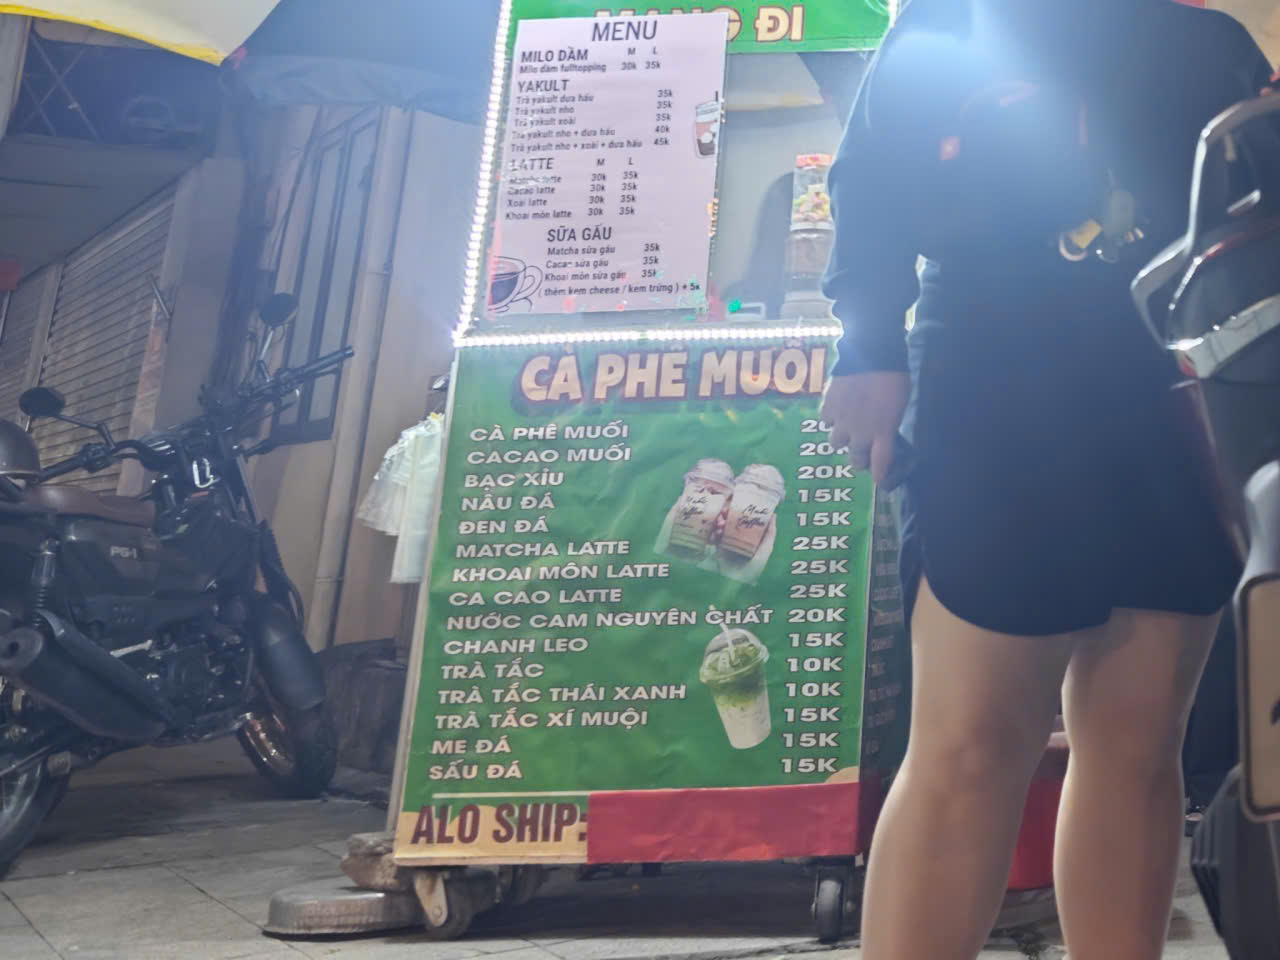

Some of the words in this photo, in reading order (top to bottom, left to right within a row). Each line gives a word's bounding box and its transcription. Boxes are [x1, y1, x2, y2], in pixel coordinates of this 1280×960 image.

[592, 20, 658, 42] MENU
[754, 4, 805, 43] ĐI
[521, 50, 554, 63] MILO
[628, 48, 636, 56] M
[652, 47, 658, 55] L
[520, 65, 538, 74] Milo
[560, 62, 607, 74] fulltopping
[621, 62, 637, 71] 30k
[645, 61, 661, 70] 35k
[518, 79, 570, 93] YAKULT
[515, 107, 528, 116] Trà
[530, 106, 556, 116] yakult
[558, 106, 575, 114] nho
[656, 101, 672, 110] 35k
[516, 96, 530, 105] Trà
[532, 95, 558, 105] yakult
[658, 90, 673, 98] 35k
[530, 117, 556, 128] yakult
[656, 112, 672, 122] 35k
[527, 129, 555, 140] yakult
[555, 129, 572, 137] nho
[654, 124, 670, 134] 40k
[527, 142, 553, 153] yakult
[554, 142, 570, 150] nho
[654, 138, 670, 146] 45k
[596, 158, 605, 166] M
[628, 156, 634, 166] L
[591, 173, 606, 182] 30k
[623, 170, 638, 180] 35k
[536, 186, 556, 194] latte
[590, 184, 605, 192] 30k
[622, 182, 637, 191] 35k
[528, 198, 548, 206] latte
[589, 195, 604, 204] 30k
[620, 194, 636, 203] 35k
[505, 210, 530, 220] Khoai
[552, 209, 572, 218] latte
[588, 207, 604, 216] 30k
[619, 206, 635, 216] 35k
[547, 225, 577, 242] SỮA
[547, 246, 579, 256] Matcha
[644, 242, 660, 252] 35k
[642, 256, 659, 265] 35k
[544, 272, 569, 282] Khoai
[568, 286, 587, 296] kem
[589, 284, 620, 295] cheese
[628, 283, 647, 294] kem
[521, 342, 582, 402] CÀ
[594, 341, 688, 401] PHÊ
[469, 424, 505, 442] CÀ
[512, 423, 557, 441] PHÊ
[564, 420, 629, 440] MUỐI
[466, 448, 560, 465] CACAO
[567, 442, 632, 462] MUỐI
[464, 473, 516, 492] BẠC
[522, 468, 564, 487] XỈU
[797, 464, 854, 480] 20K
[461, 493, 512, 512] NÂU
[520, 492, 555, 510] ĐÁ
[797, 488, 853, 504] 15K
[458, 520, 506, 535] ĐEN
[514, 515, 549, 534] ĐÁ
[796, 511, 852, 527] 15K
[455, 542, 560, 559] MATCHA
[567, 540, 630, 556] LATTE
[792, 535, 850, 551] 25K
[452, 566, 532, 583] KHOAI
[538, 562, 598, 581] MÔN
[606, 563, 670, 578] LATTE
[790, 559, 849, 576] 25K
[448, 591, 486, 607] CA
[493, 590, 550, 606] CAO
[559, 588, 622, 604] LATTE
[789, 583, 848, 599] 25K
[446, 612, 522, 631] NƯỚC
[528, 613, 588, 629] CAM
[596, 608, 697, 628] NGUYÊN
[705, 603, 774, 626] CHẤT
[788, 607, 846, 624] 20K
[443, 638, 536, 656] CHANH
[543, 638, 589, 654] LEO
[788, 632, 845, 648] 15K
[441, 660, 487, 680] TRÀ
[494, 657, 545, 679] TẮC
[786, 656, 844, 673] 10K
[438, 685, 484, 705] TRÀ
[492, 682, 542, 704] TẮC
[549, 682, 604, 702] THÁI
[613, 685, 687, 701] XANH
[785, 682, 842, 698] 10K
[434, 710, 480, 730] TRÀ
[488, 707, 539, 729] TẮC
[546, 708, 576, 728] XÍ
[581, 707, 648, 730] MUỘI
[784, 706, 841, 723] 15K
[432, 740, 468, 755] ME
[475, 734, 512, 754] ĐÁ
[782, 732, 840, 748] 15K
[428, 758, 478, 780] SẤU
[486, 760, 523, 780] ĐÁ
[780, 757, 838, 774] 15K
[410, 803, 481, 845] ALO
[492, 802, 588, 844] SHIP:
